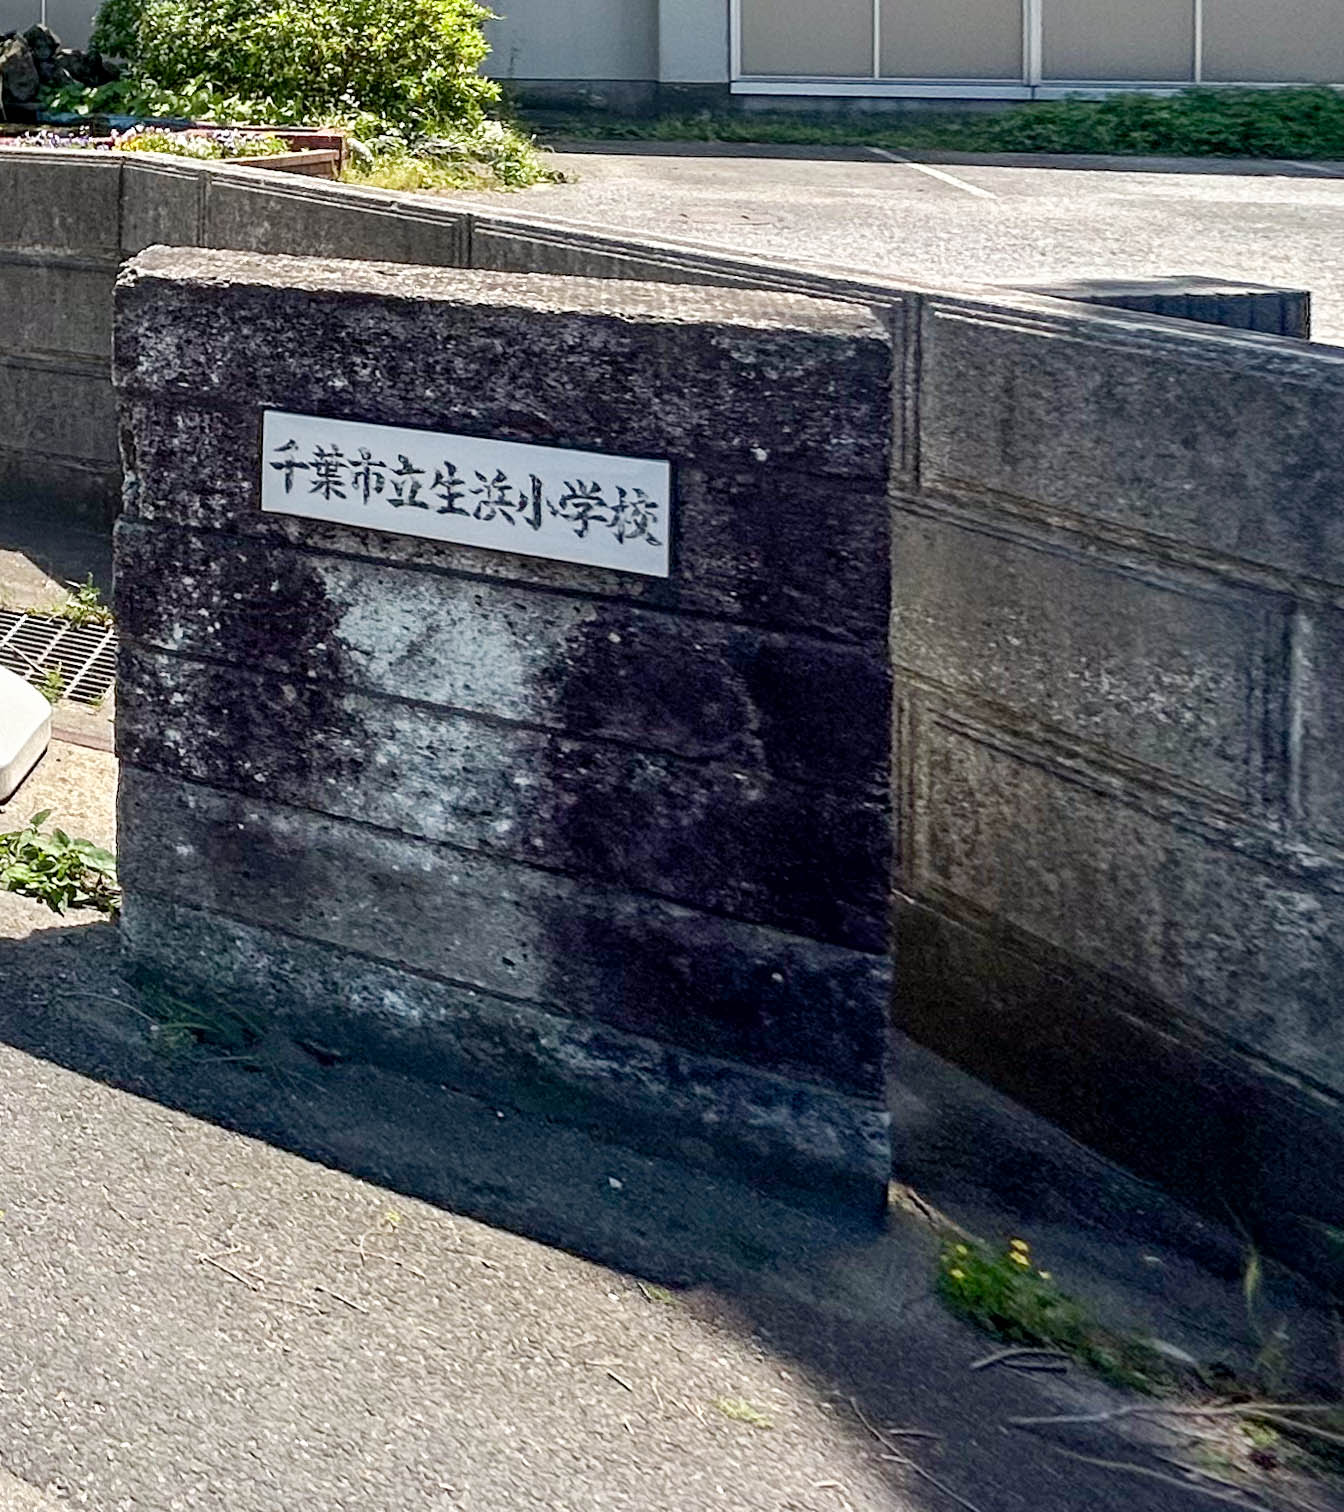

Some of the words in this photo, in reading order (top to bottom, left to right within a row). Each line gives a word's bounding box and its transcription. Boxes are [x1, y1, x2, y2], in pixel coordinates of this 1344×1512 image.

[269, 439, 663, 546] 千葉市立生浜小学校
